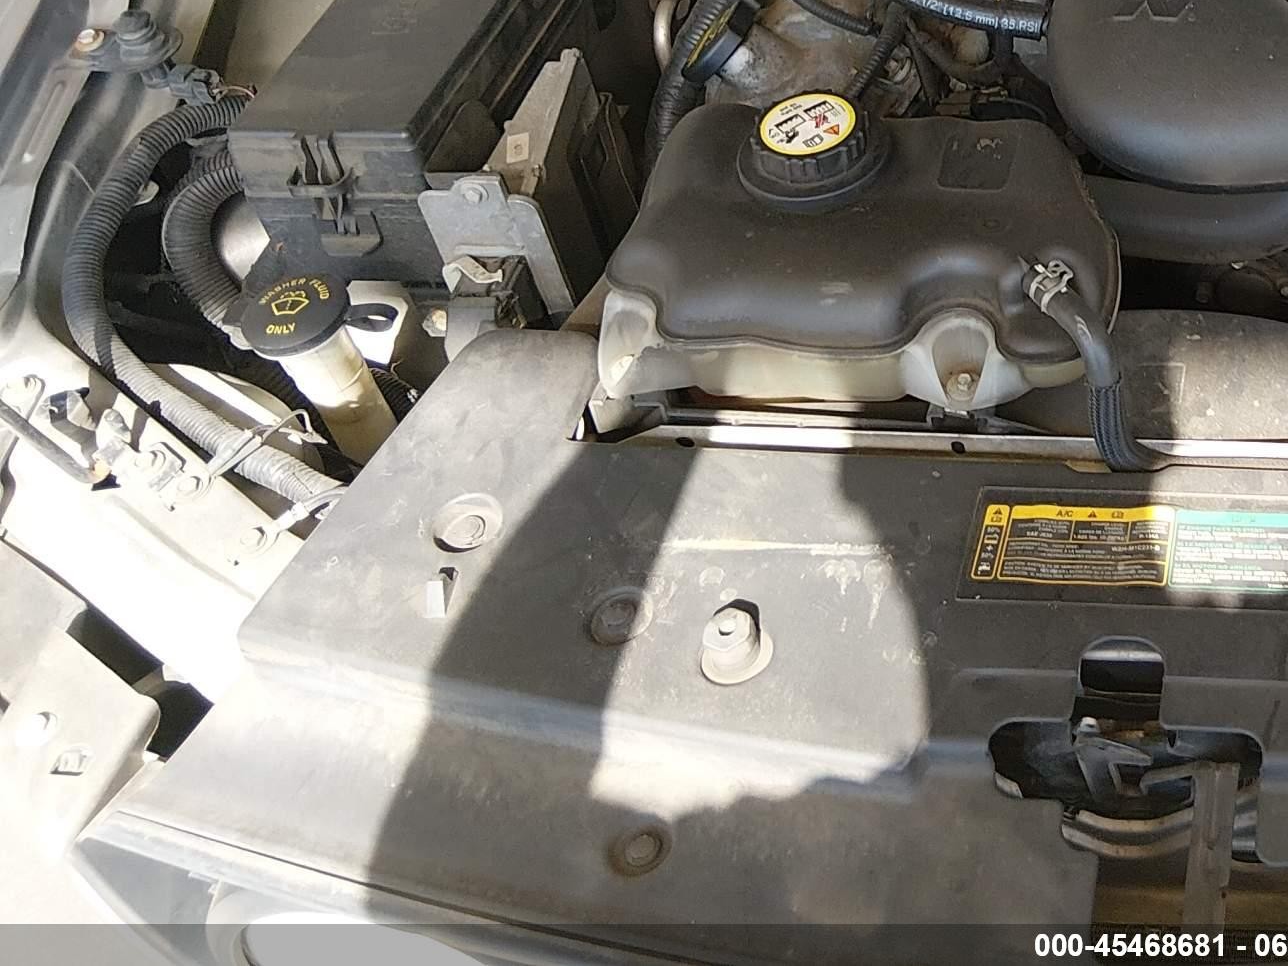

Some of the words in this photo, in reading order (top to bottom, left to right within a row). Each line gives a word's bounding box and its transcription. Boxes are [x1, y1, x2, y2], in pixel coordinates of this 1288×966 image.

[309, 278, 331, 301] FLUID
[265, 322, 297, 335] ONLY
[1056, 509, 1074, 518] A/C
